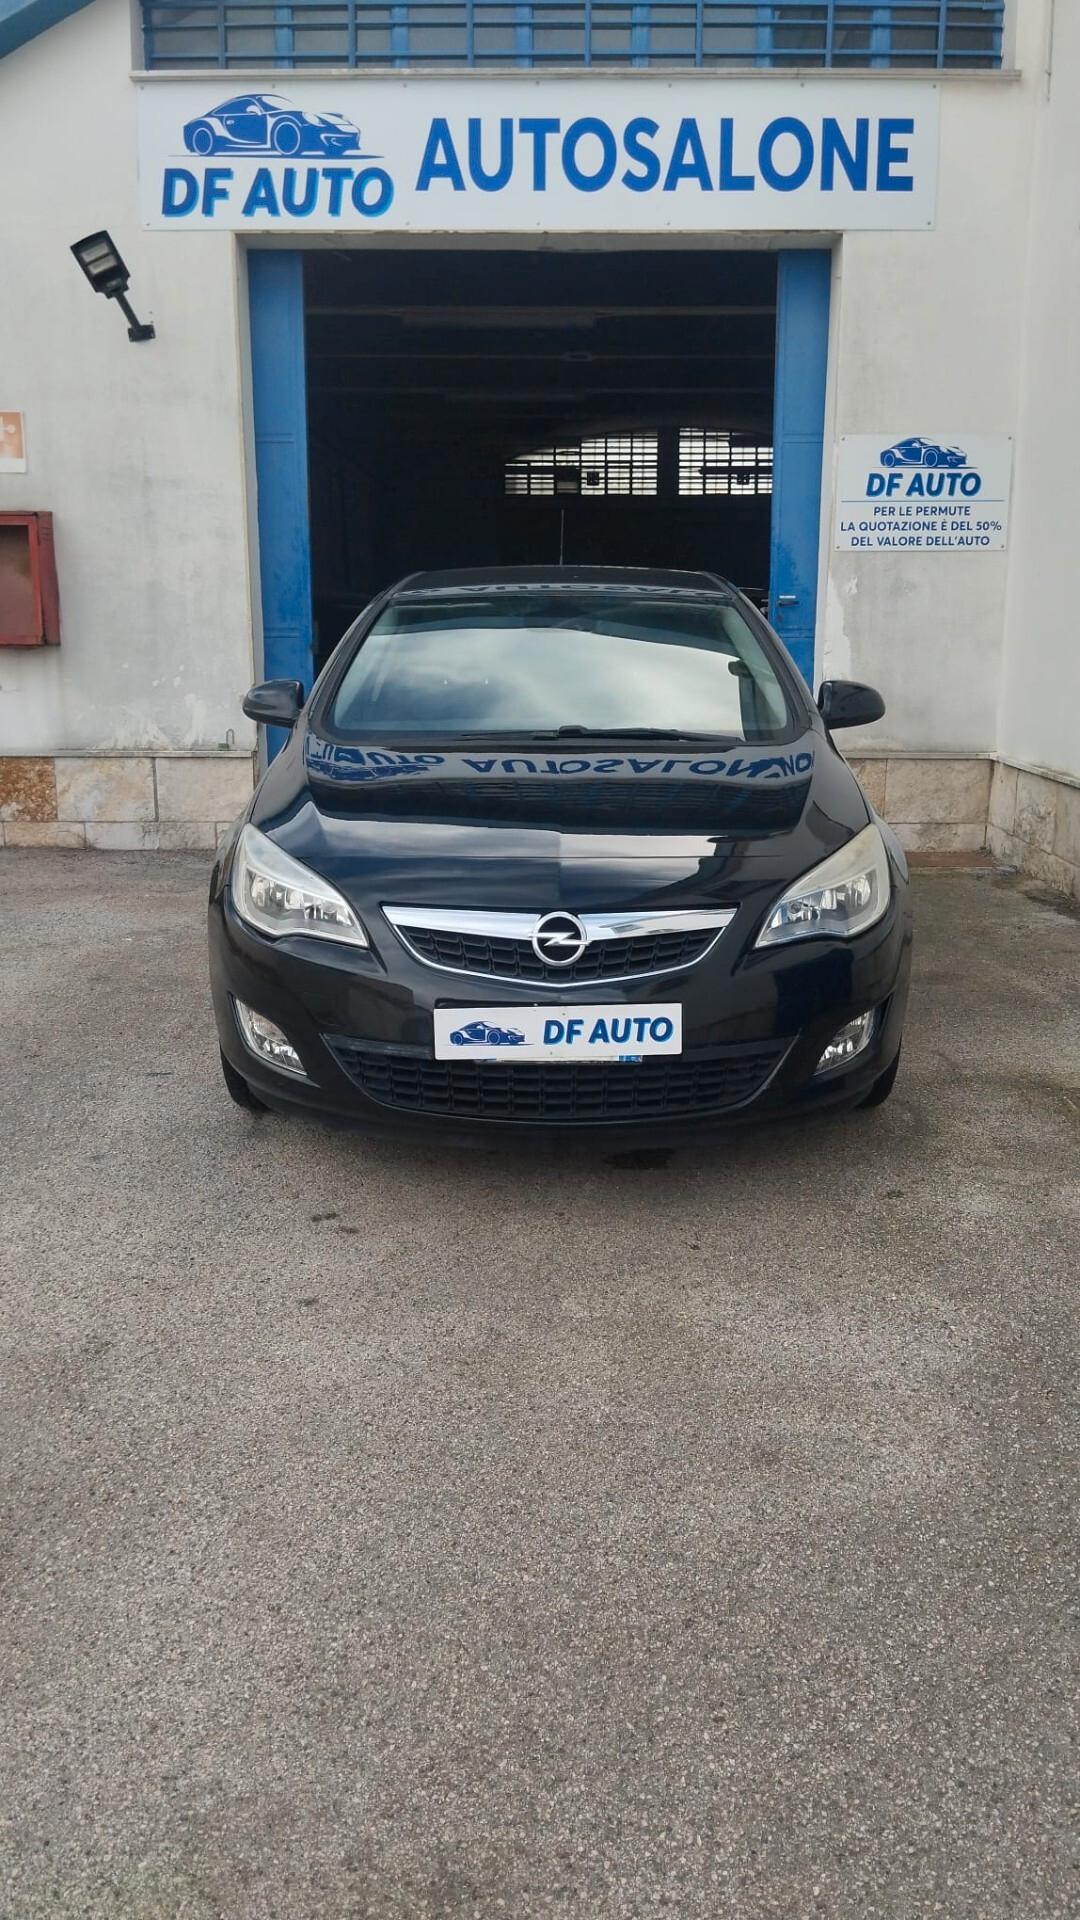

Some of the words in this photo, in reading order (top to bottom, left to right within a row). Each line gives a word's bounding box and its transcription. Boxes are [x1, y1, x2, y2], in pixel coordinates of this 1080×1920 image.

[415, 116, 914, 192] AUTOSALONE
[161, 167, 233, 217] DF
[241, 167, 395, 217] AUTO
[866, 472, 903, 497] DF
[905, 472, 982, 497] AUTO
[873, 506, 896, 517] PER
[899, 506, 912, 517] LE
[915, 506, 971, 516] PERMUTE
[840, 521, 856, 532] LA
[858, 521, 937, 532] QUOTAZIONE
[940, 518, 948, 531] È
[951, 521, 973, 531] DEL
[975, 521, 1002, 531] 50%
[851, 536, 873, 547] DEL
[877, 536, 922, 546] VALORE
[926, 536, 990, 546] DELL'AUTO
[543, 1019, 584, 1045] DF
[588, 1016, 674, 1044] AUTO
